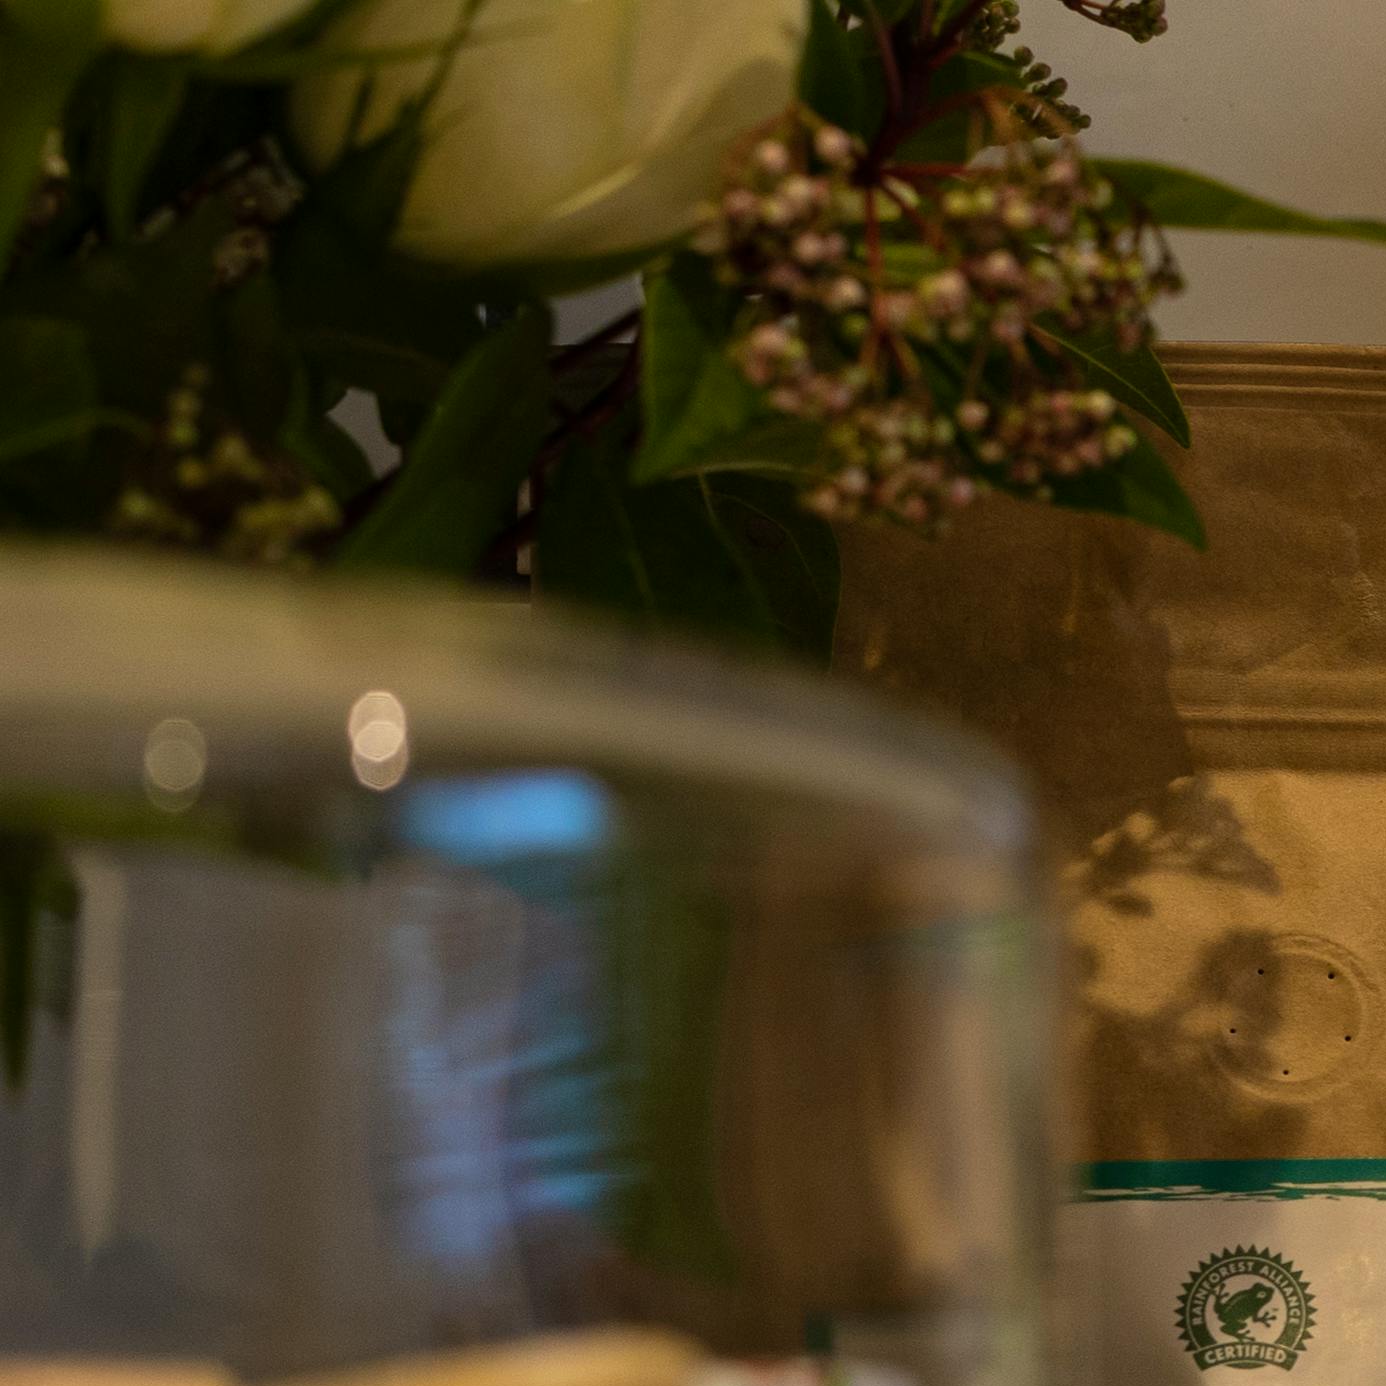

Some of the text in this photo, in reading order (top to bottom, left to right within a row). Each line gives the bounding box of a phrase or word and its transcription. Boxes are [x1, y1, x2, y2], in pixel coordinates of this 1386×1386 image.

[1192, 1261, 1301, 1326] RAINFOREST ALLIANCE
[1204, 1344, 1287, 1364] CERTIFIED
